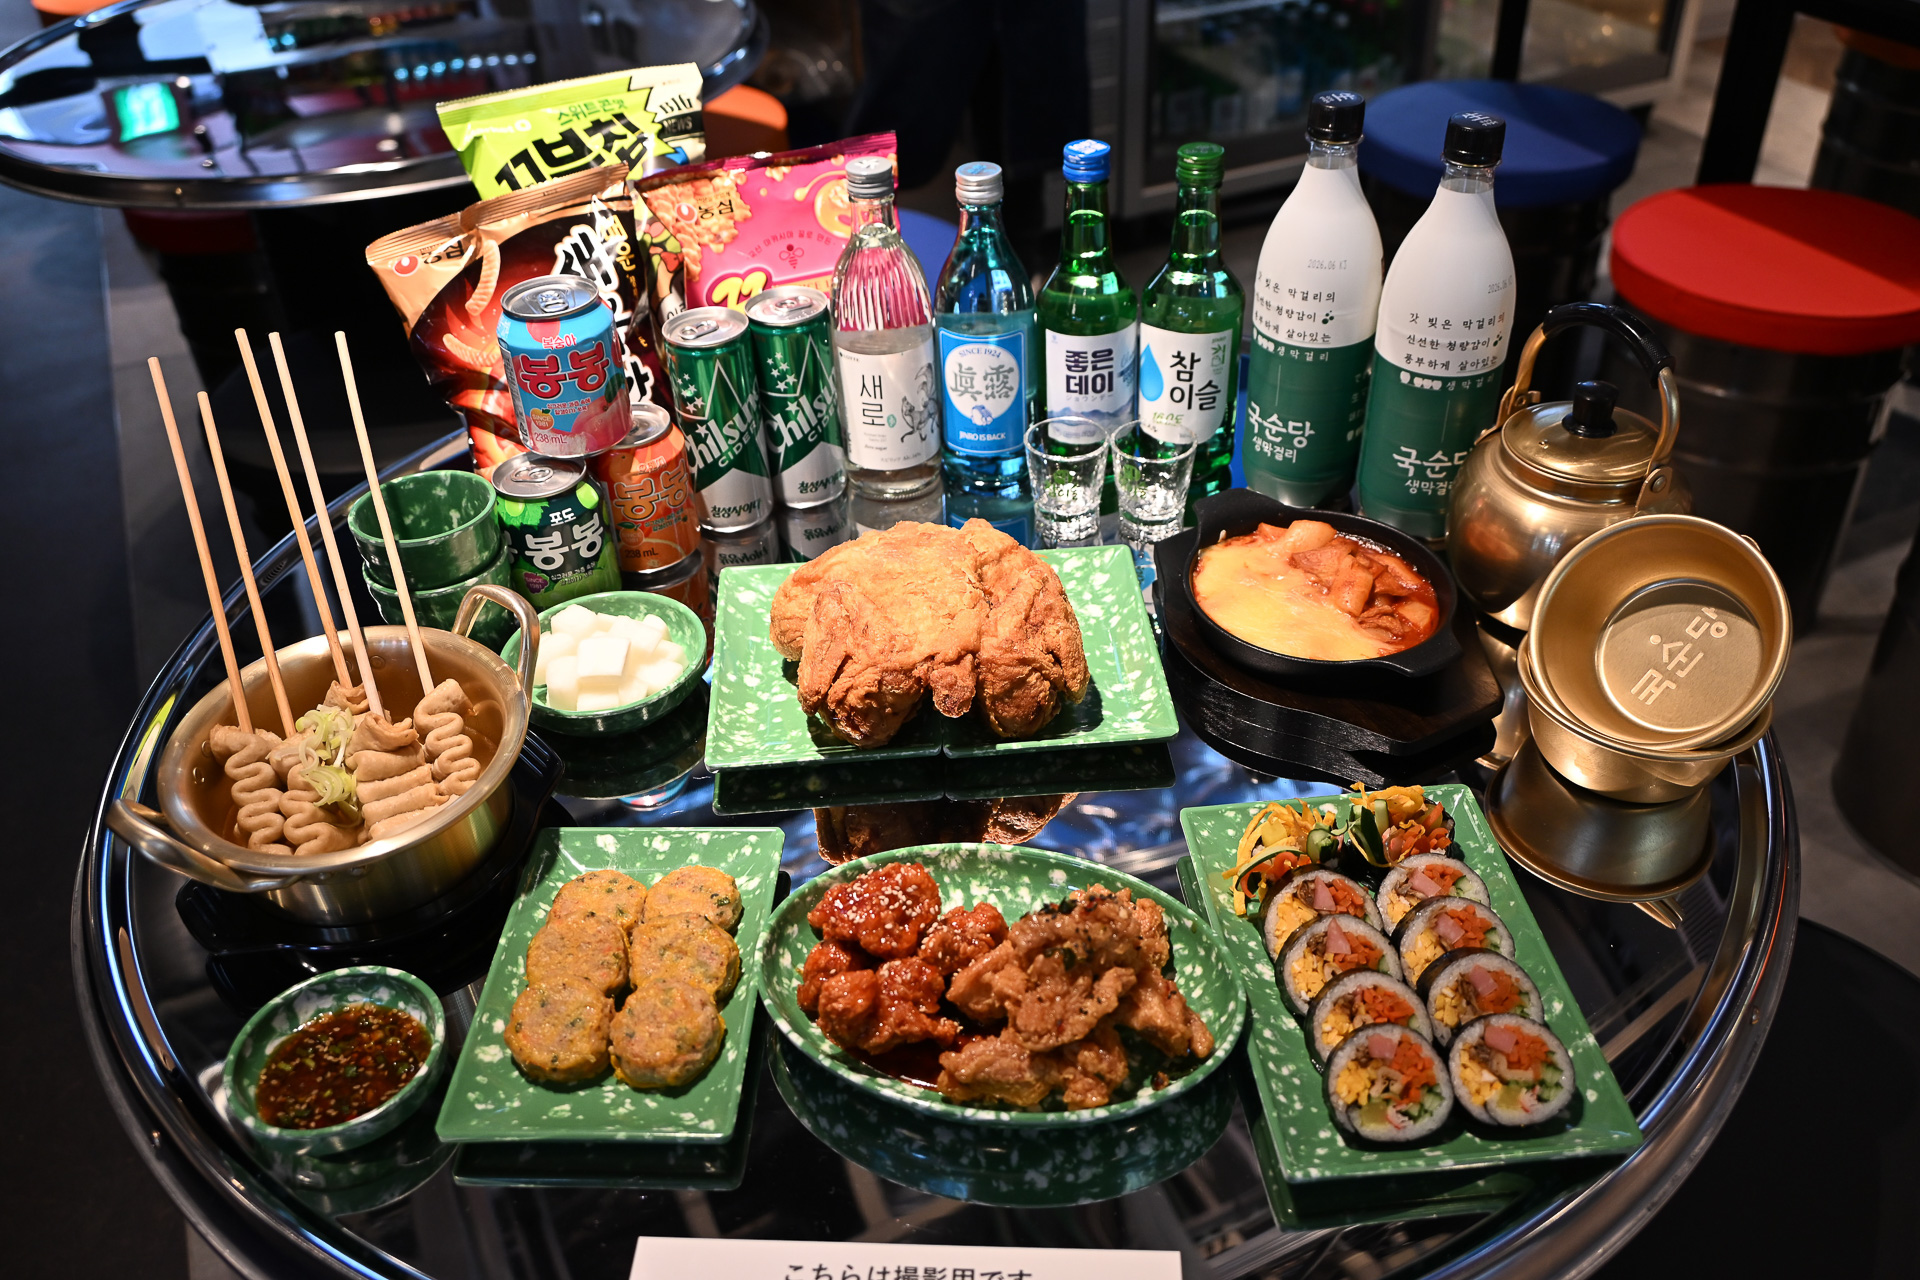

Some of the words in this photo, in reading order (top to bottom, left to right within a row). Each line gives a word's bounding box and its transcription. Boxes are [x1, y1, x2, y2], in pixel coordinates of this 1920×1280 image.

[558, 99, 628, 126] 스위트콘맛
[663, 116, 693, 134] NEWS
[698, 199, 734, 220] 농심
[1288, 287, 1336, 303] 막걸리의
[1276, 304, 1317, 323] 청량감이
[1409, 313, 1420, 324] 갓
[1428, 317, 1452, 330] 빚은
[1462, 312, 1505, 330] 막걸리의
[542, 333, 577, 350] 복숭아
[1286, 328, 1332, 343] 살아있는
[1407, 334, 1440, 350] 신선한
[1447, 337, 1490, 352] 청량감이
[959, 347, 982, 358] SINCE
[984, 348, 1002, 358] 1924
[1065, 348, 1114, 373] 좋은
[1277, 345, 1329, 362] 생막걸리
[1404, 353, 1450, 371] 풍부하게
[1458, 355, 1498, 371] 살아있는
[520, 341, 610, 399] 봉봉
[1170, 351, 1201, 382] 참
[950, 362, 1015, 401] 眞露
[1066, 370, 1114, 395] 데이
[860, 375, 885, 426] 새로
[1170, 380, 1221, 410] 이슬
[1248, 401, 1315, 448] 국순당
[534, 432, 549, 443] 238
[986, 432, 1006, 441] BACK
[1252, 436, 1297, 463] 생막걸리
[638, 456, 666, 472] 오렌지
[614, 459, 688, 520] 봉봉
[549, 507, 577, 526] 포도
[711, 499, 761, 518] 칠성사이다
[525, 512, 604, 571] 봉봉
[625, 548, 641, 558] 238
[643, 547, 659, 557] mL
[1630, 606, 1728, 705] 국순당
